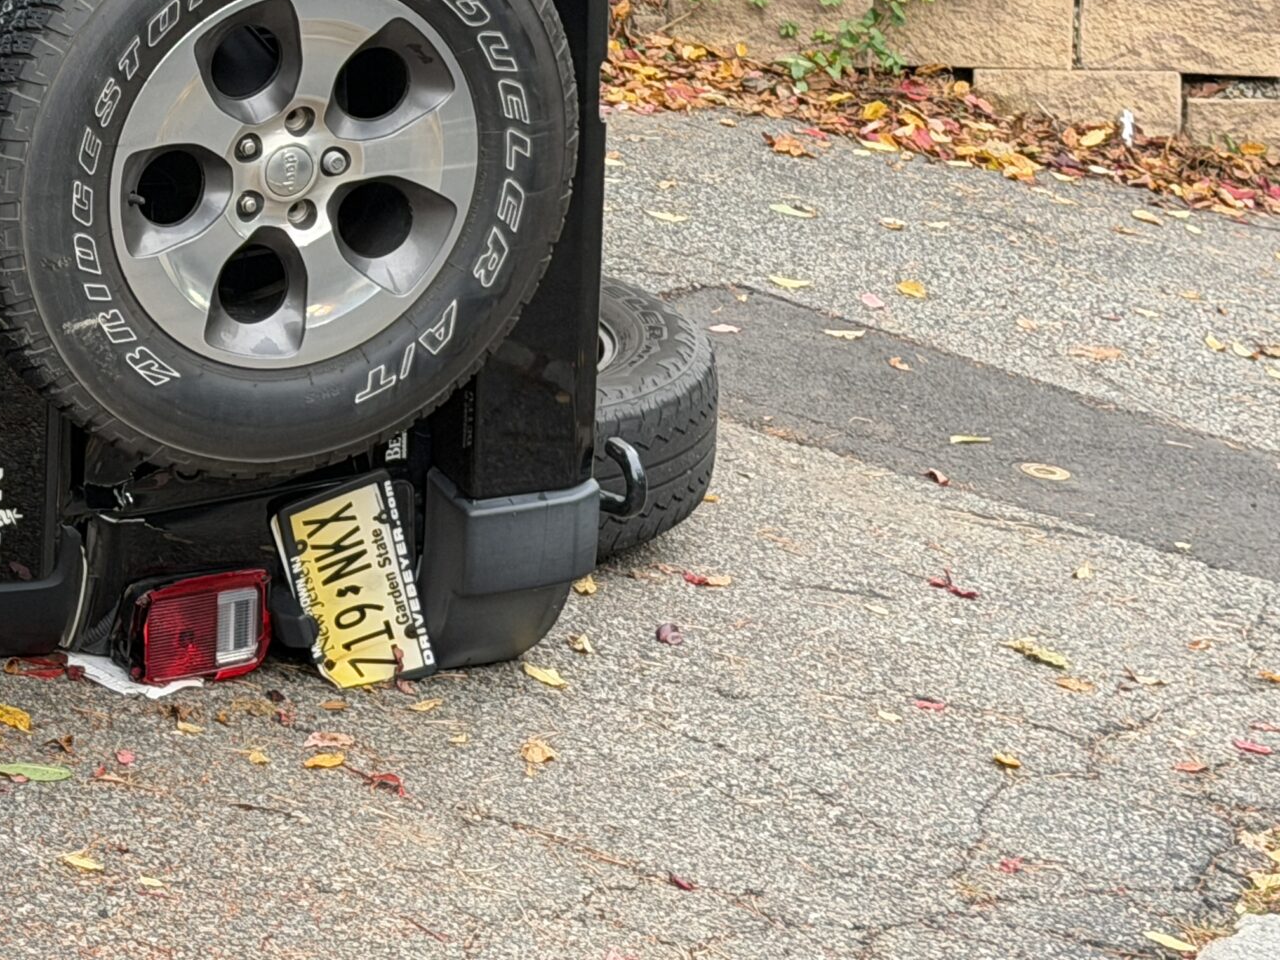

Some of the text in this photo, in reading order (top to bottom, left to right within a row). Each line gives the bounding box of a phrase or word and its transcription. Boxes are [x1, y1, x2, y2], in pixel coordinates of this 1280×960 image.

[354, 298, 459, 404] A/T
[302, 501, 373, 586] NKX
[371, 527, 411, 626] Garden State
[383, 479, 436, 667] DRIVEBEYER.com
